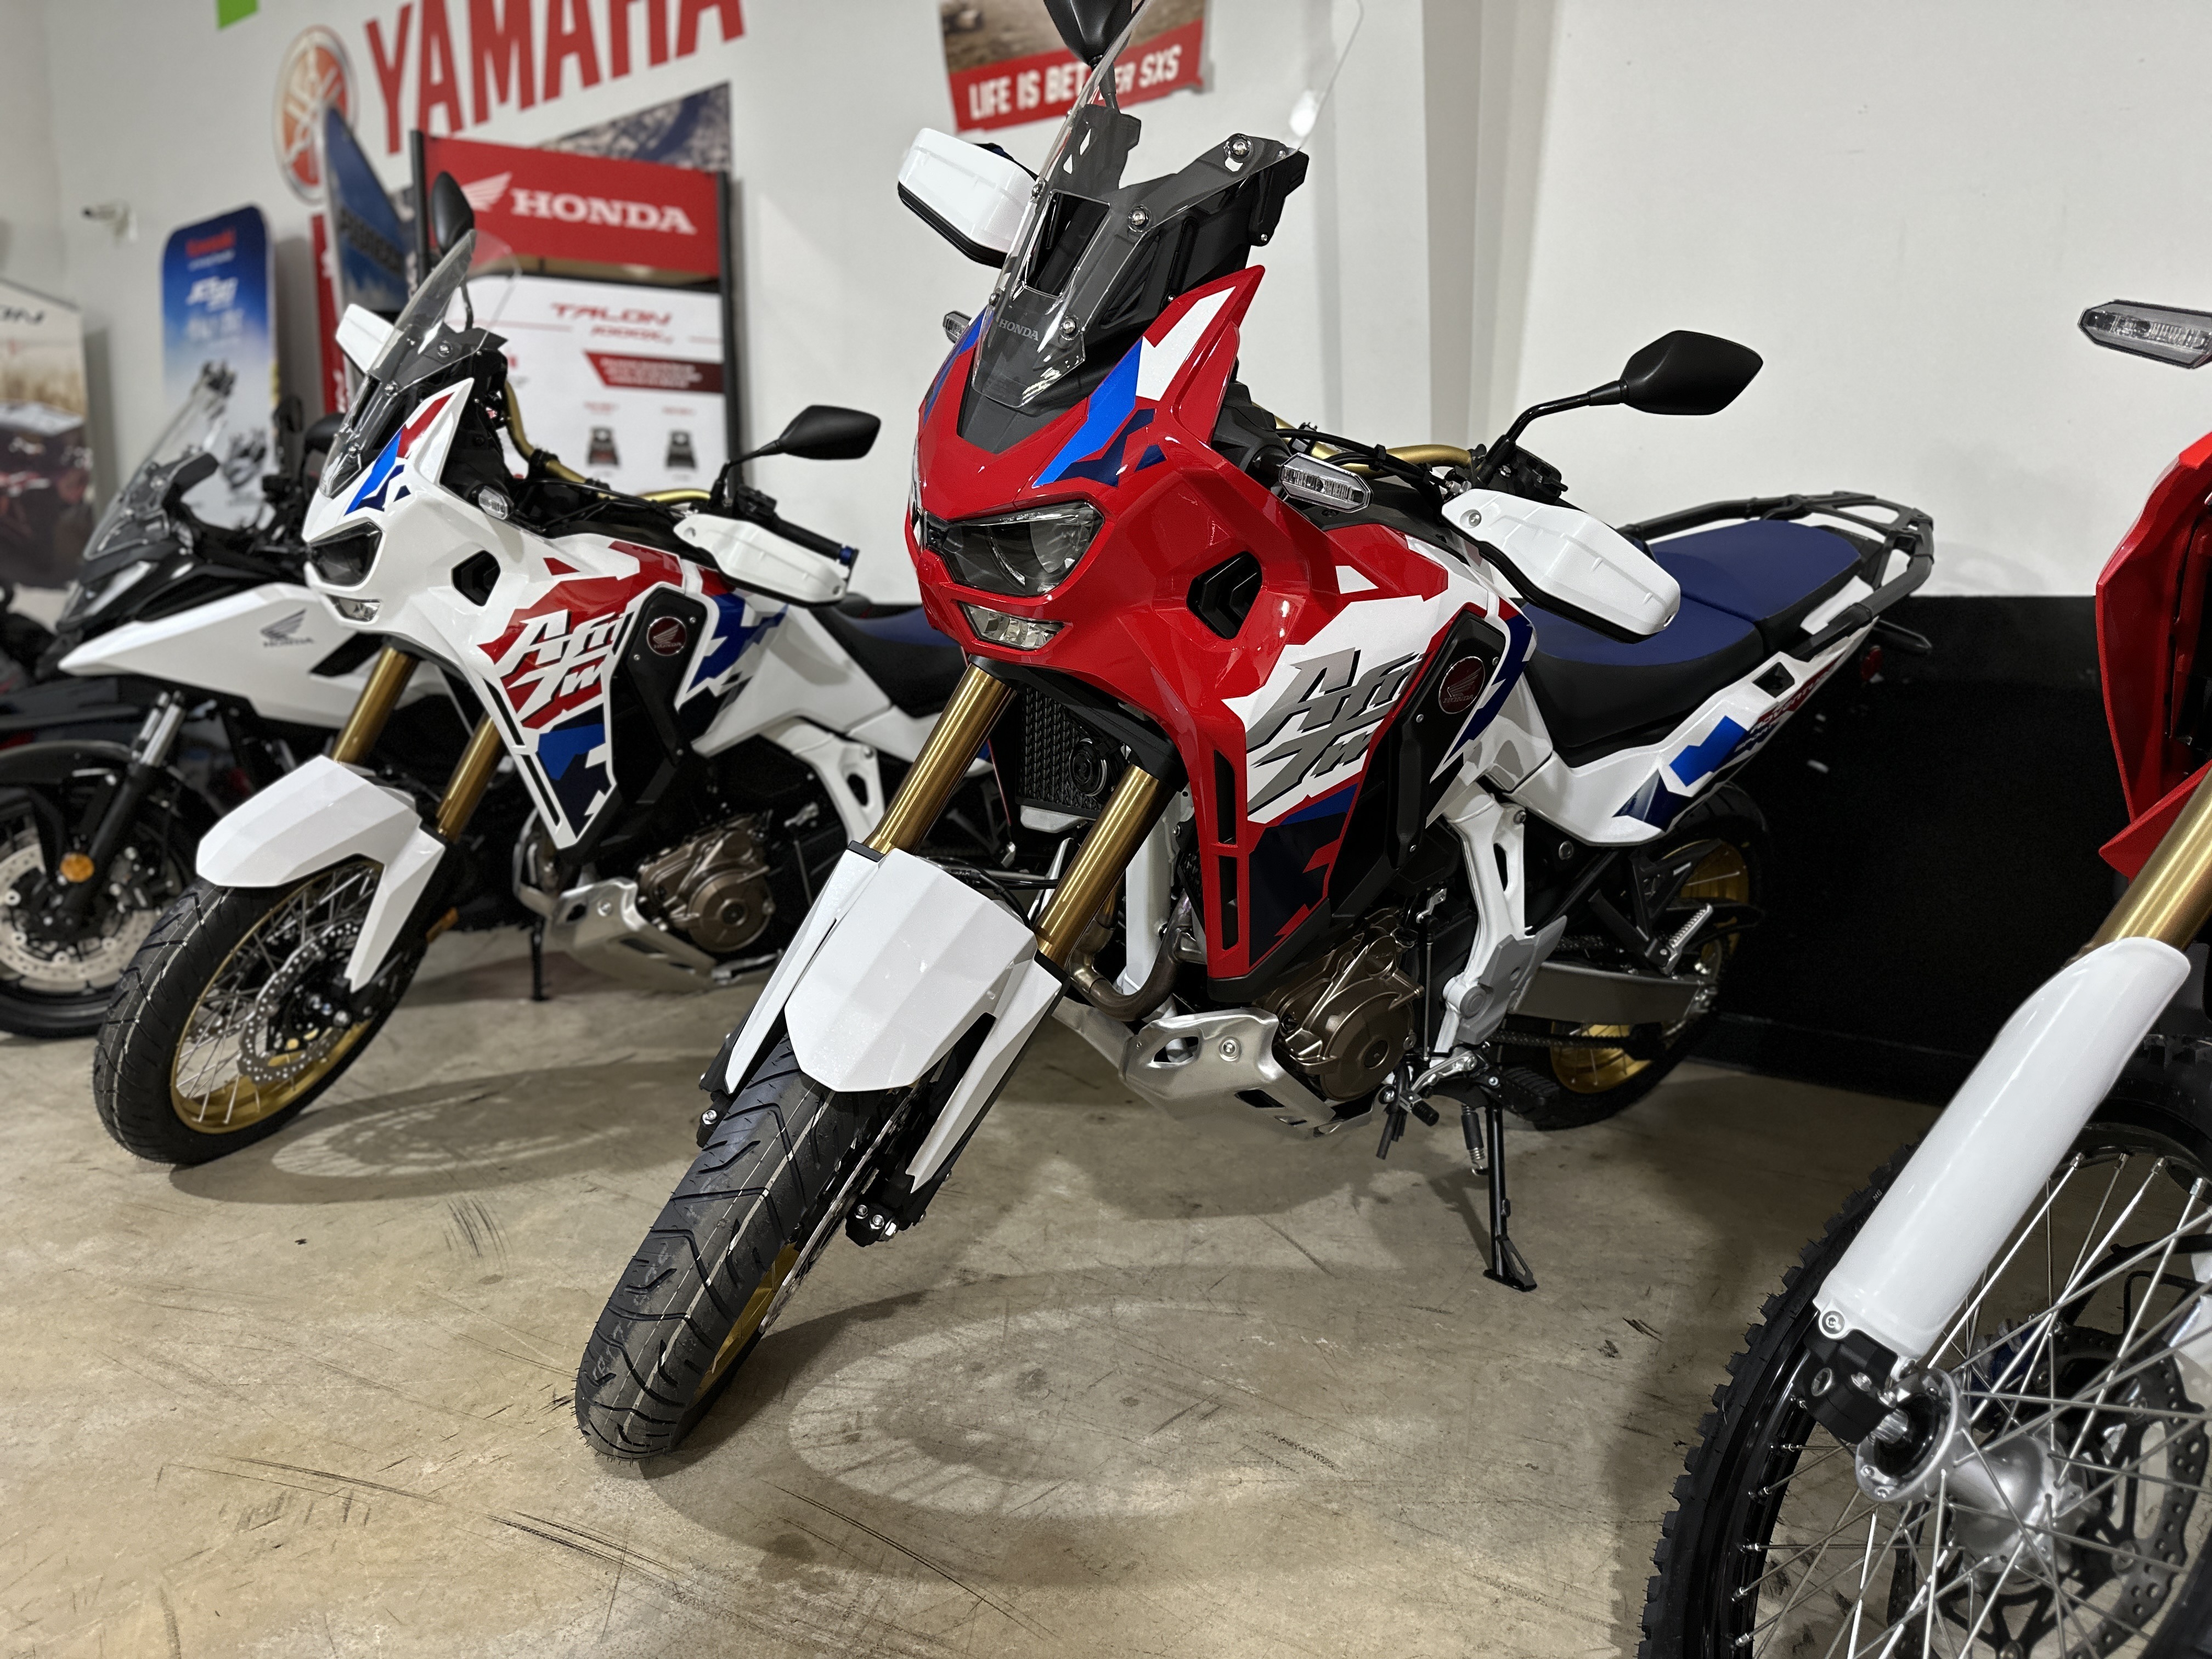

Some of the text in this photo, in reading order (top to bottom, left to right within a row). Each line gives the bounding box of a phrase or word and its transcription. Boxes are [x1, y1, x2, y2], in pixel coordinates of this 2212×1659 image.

[969, 44, 1182, 121] LIFE IS BETER SXS
[510, 188, 698, 236] HONDA
[551, 303, 672, 326] TALON
[998, 318, 1039, 341] HONDA
[1442, 694, 1474, 704] HONDA
